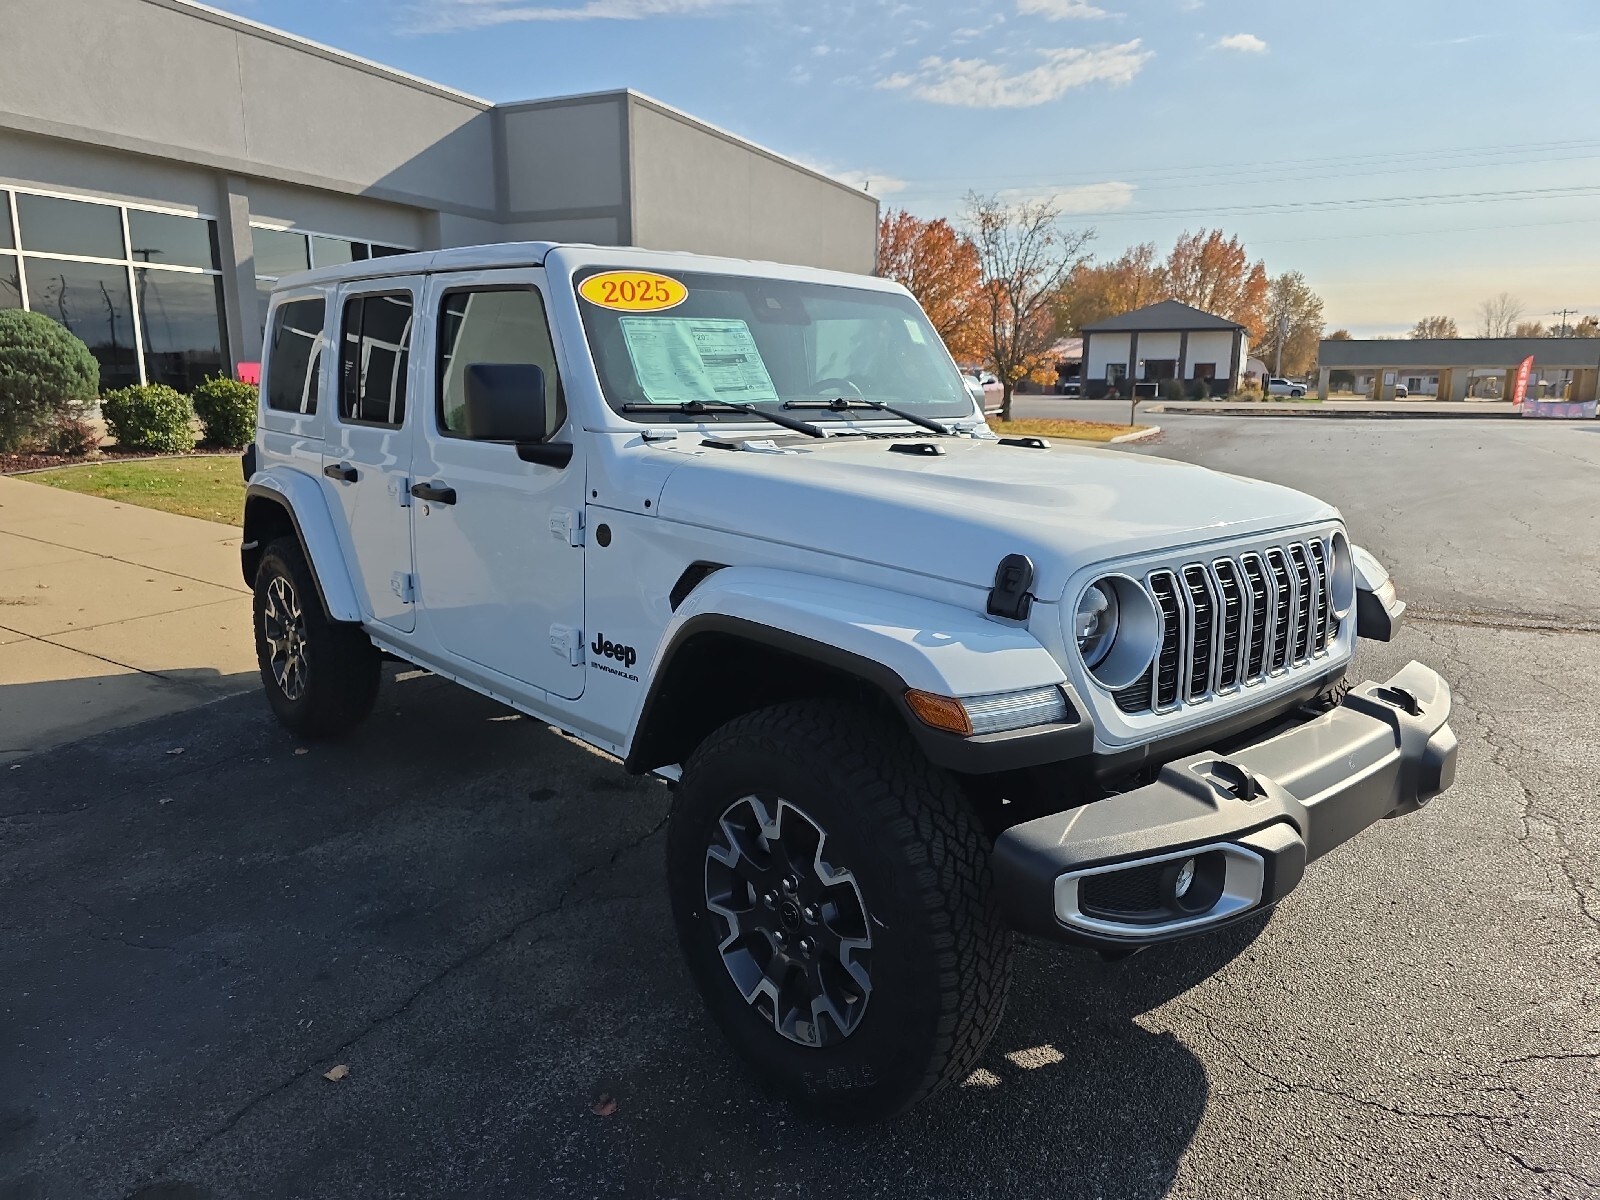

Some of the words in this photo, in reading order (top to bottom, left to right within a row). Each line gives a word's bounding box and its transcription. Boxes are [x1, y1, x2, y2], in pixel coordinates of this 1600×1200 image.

[601, 280, 670, 303] 2025
[1520, 360, 1530, 378] CAR
[1517, 380, 1527, 402] WASH
[591, 632, 637, 669] Jeep
[597, 663, 639, 682] WRANGLER
